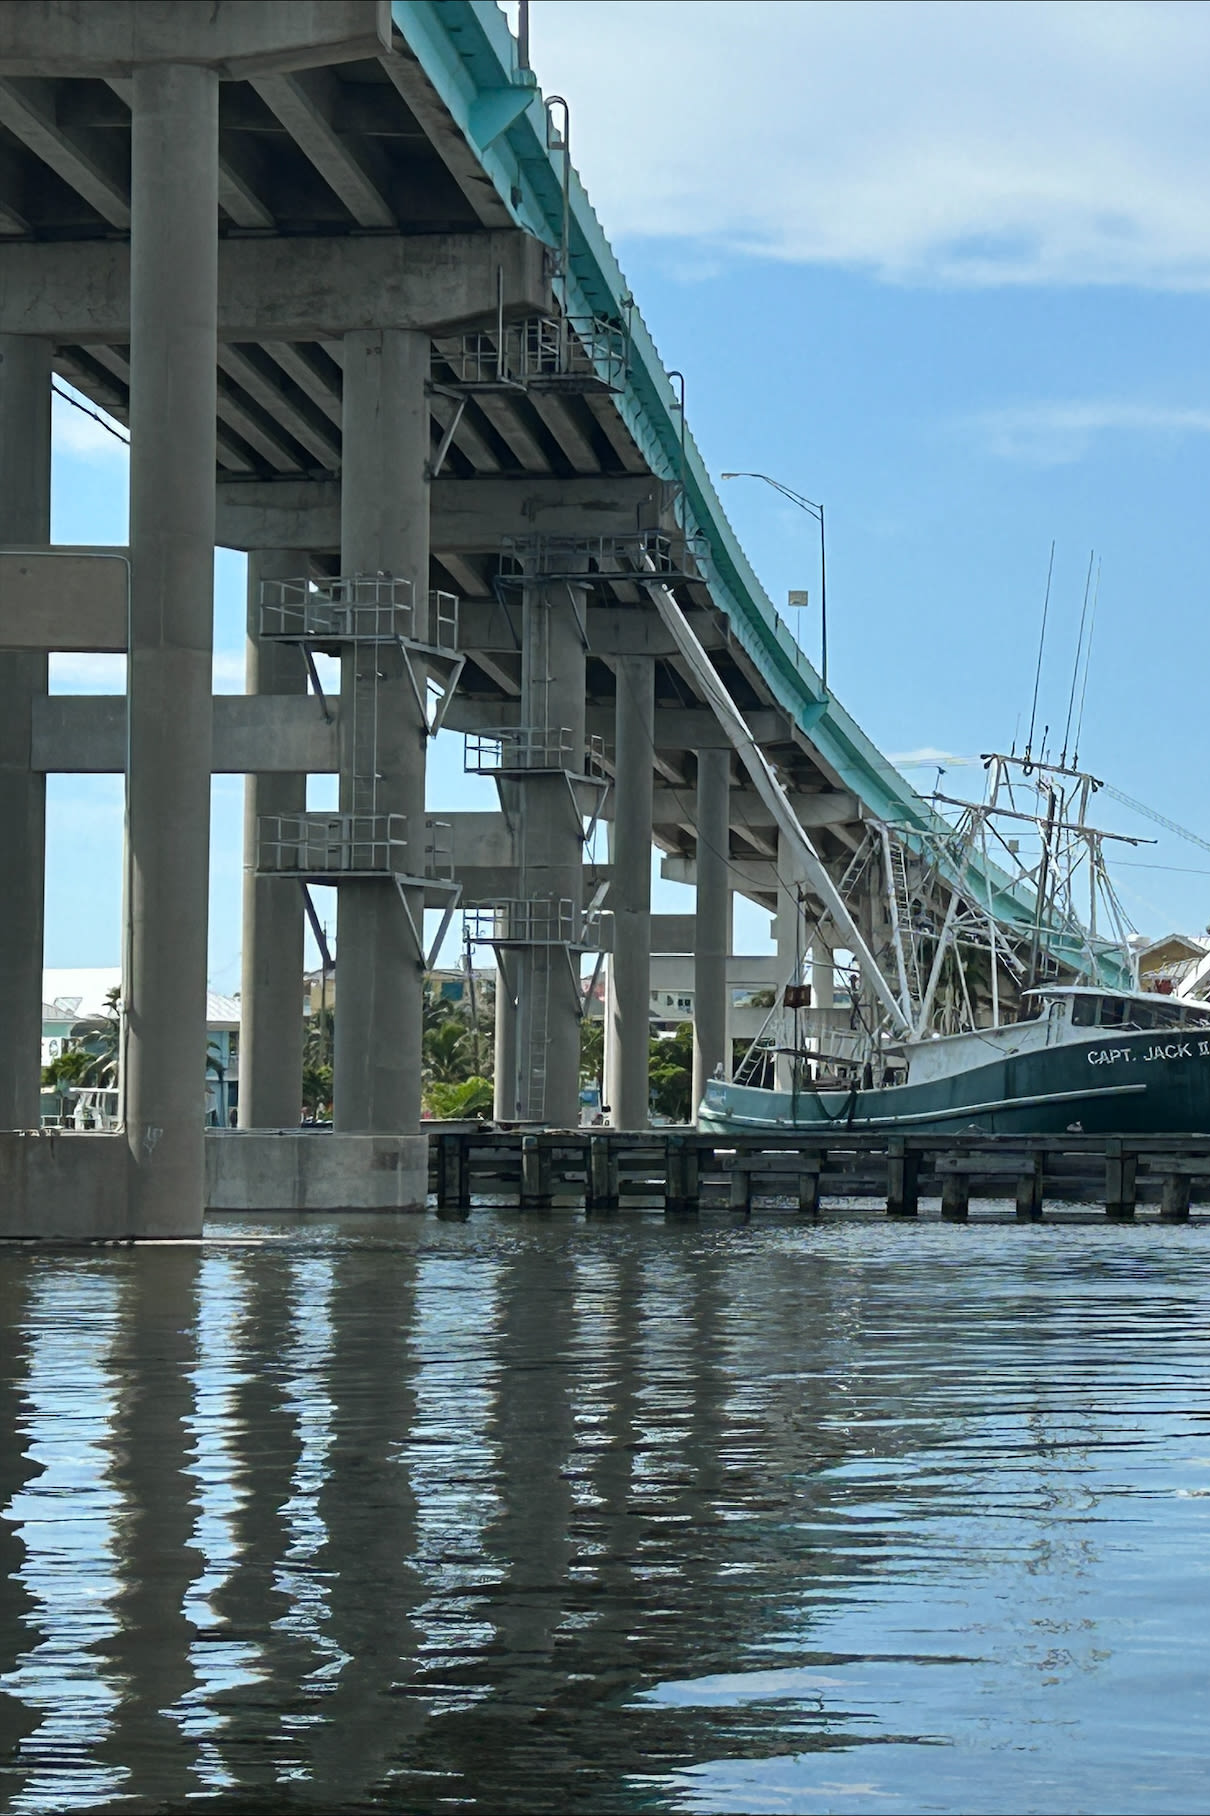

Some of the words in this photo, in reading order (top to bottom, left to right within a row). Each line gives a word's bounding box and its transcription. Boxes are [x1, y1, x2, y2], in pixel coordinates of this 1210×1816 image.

[1087, 1047, 1137, 1065] CAPT.
[1143, 1043, 1193, 1061] JACK
[1197, 1040, 1210, 1056] II
